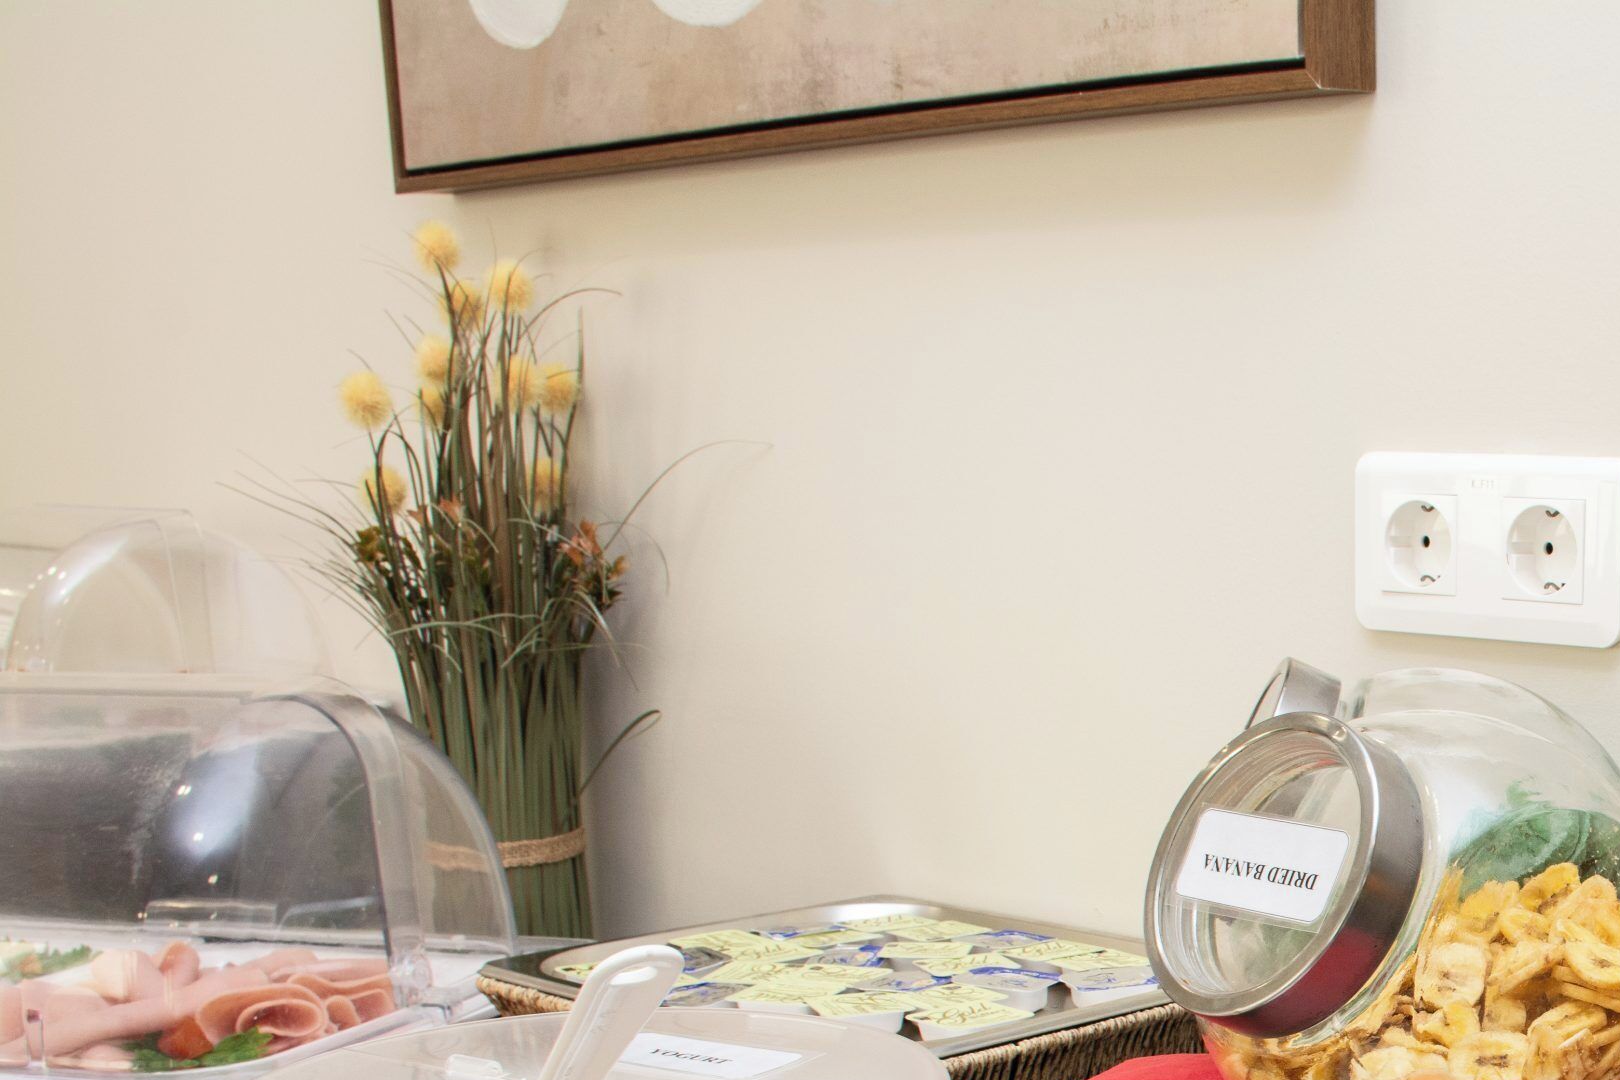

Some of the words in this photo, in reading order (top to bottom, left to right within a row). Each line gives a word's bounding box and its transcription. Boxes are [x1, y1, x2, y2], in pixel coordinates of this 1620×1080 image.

[1203, 853, 1266, 881] BANANA
[1267, 866, 1319, 890] DRIED
[647, 1047, 734, 1065] YOGURT
